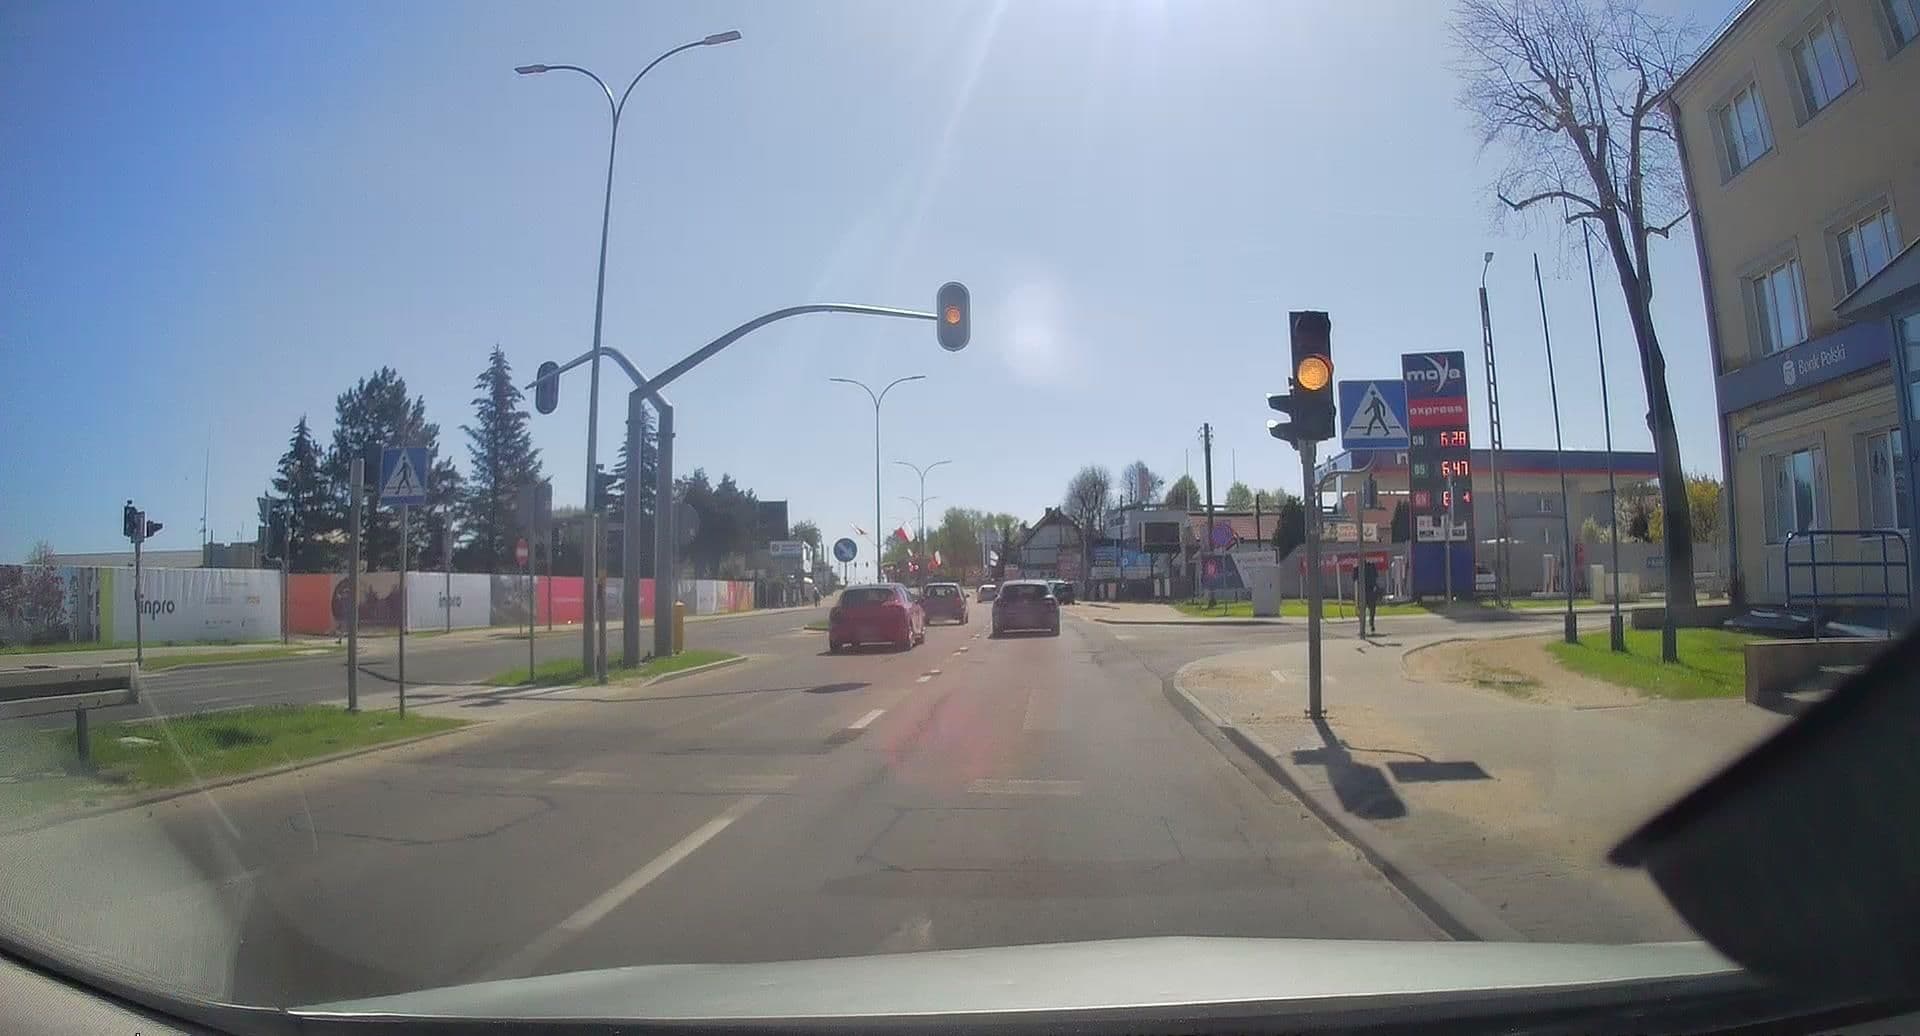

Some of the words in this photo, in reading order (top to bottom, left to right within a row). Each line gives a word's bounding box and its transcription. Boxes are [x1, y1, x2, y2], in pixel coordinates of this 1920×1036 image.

[1798, 353, 1819, 375] Bank
[1820, 343, 1847, 368] Polski
[1406, 355, 1461, 393] moya
[1409, 405, 1463, 416] express
[138, 594, 176, 621] inpro
